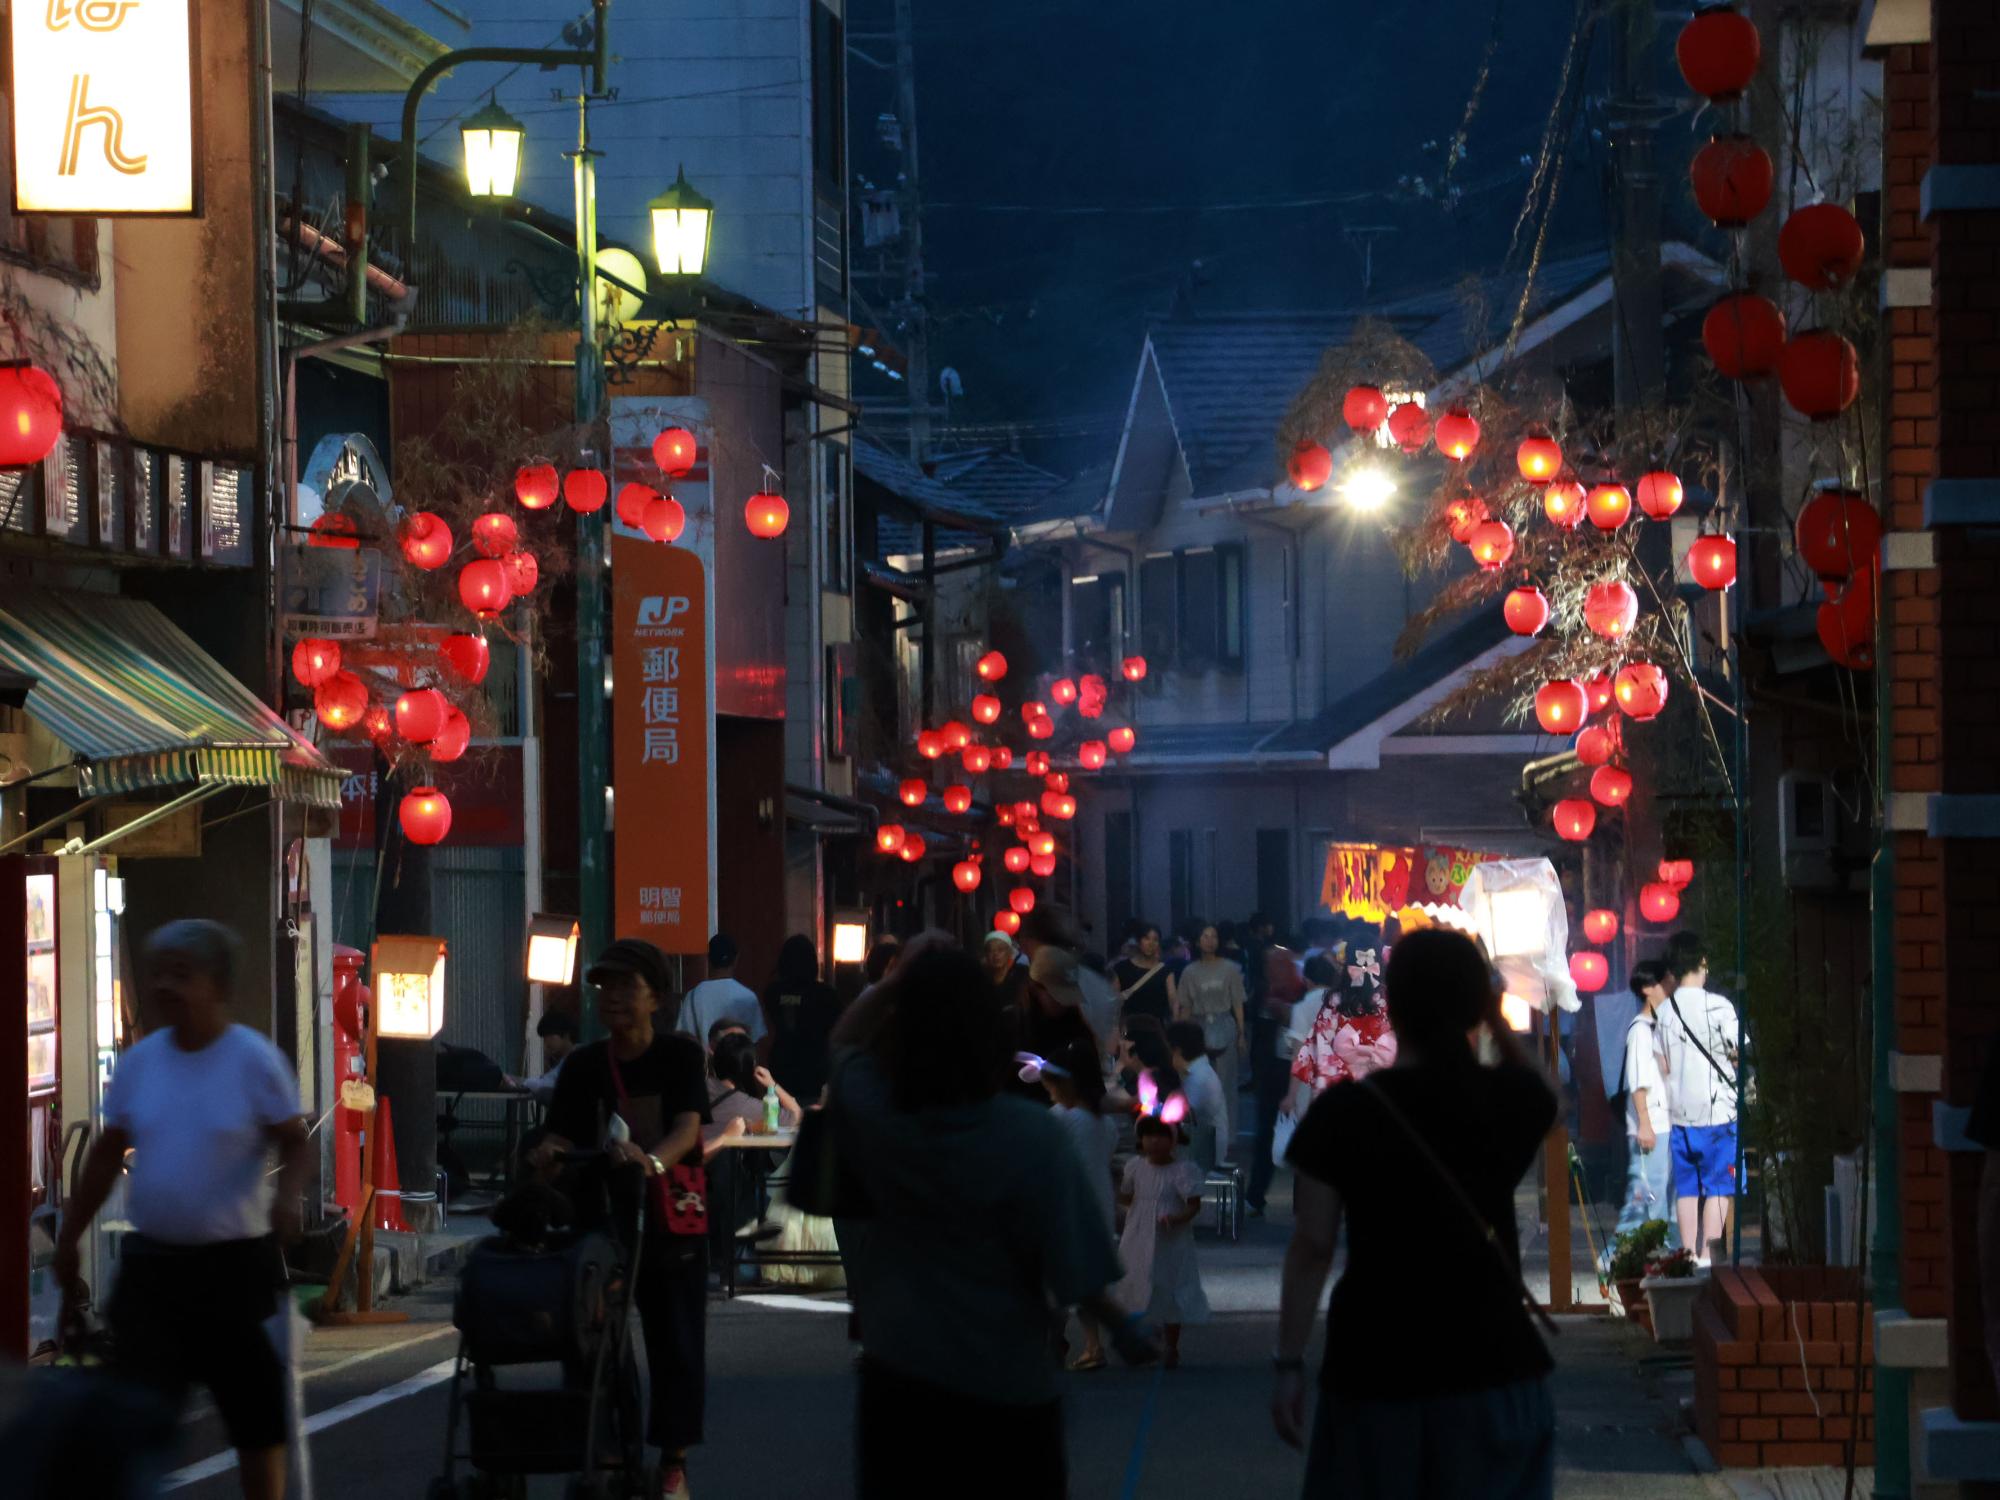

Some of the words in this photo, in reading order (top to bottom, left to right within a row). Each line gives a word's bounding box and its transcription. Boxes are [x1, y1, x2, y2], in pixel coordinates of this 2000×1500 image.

[637, 596, 690, 625] JP
[634, 627, 685, 637] NETWORK
[641, 646, 679, 764] 郵便局
[640, 887, 681, 908] 明智
